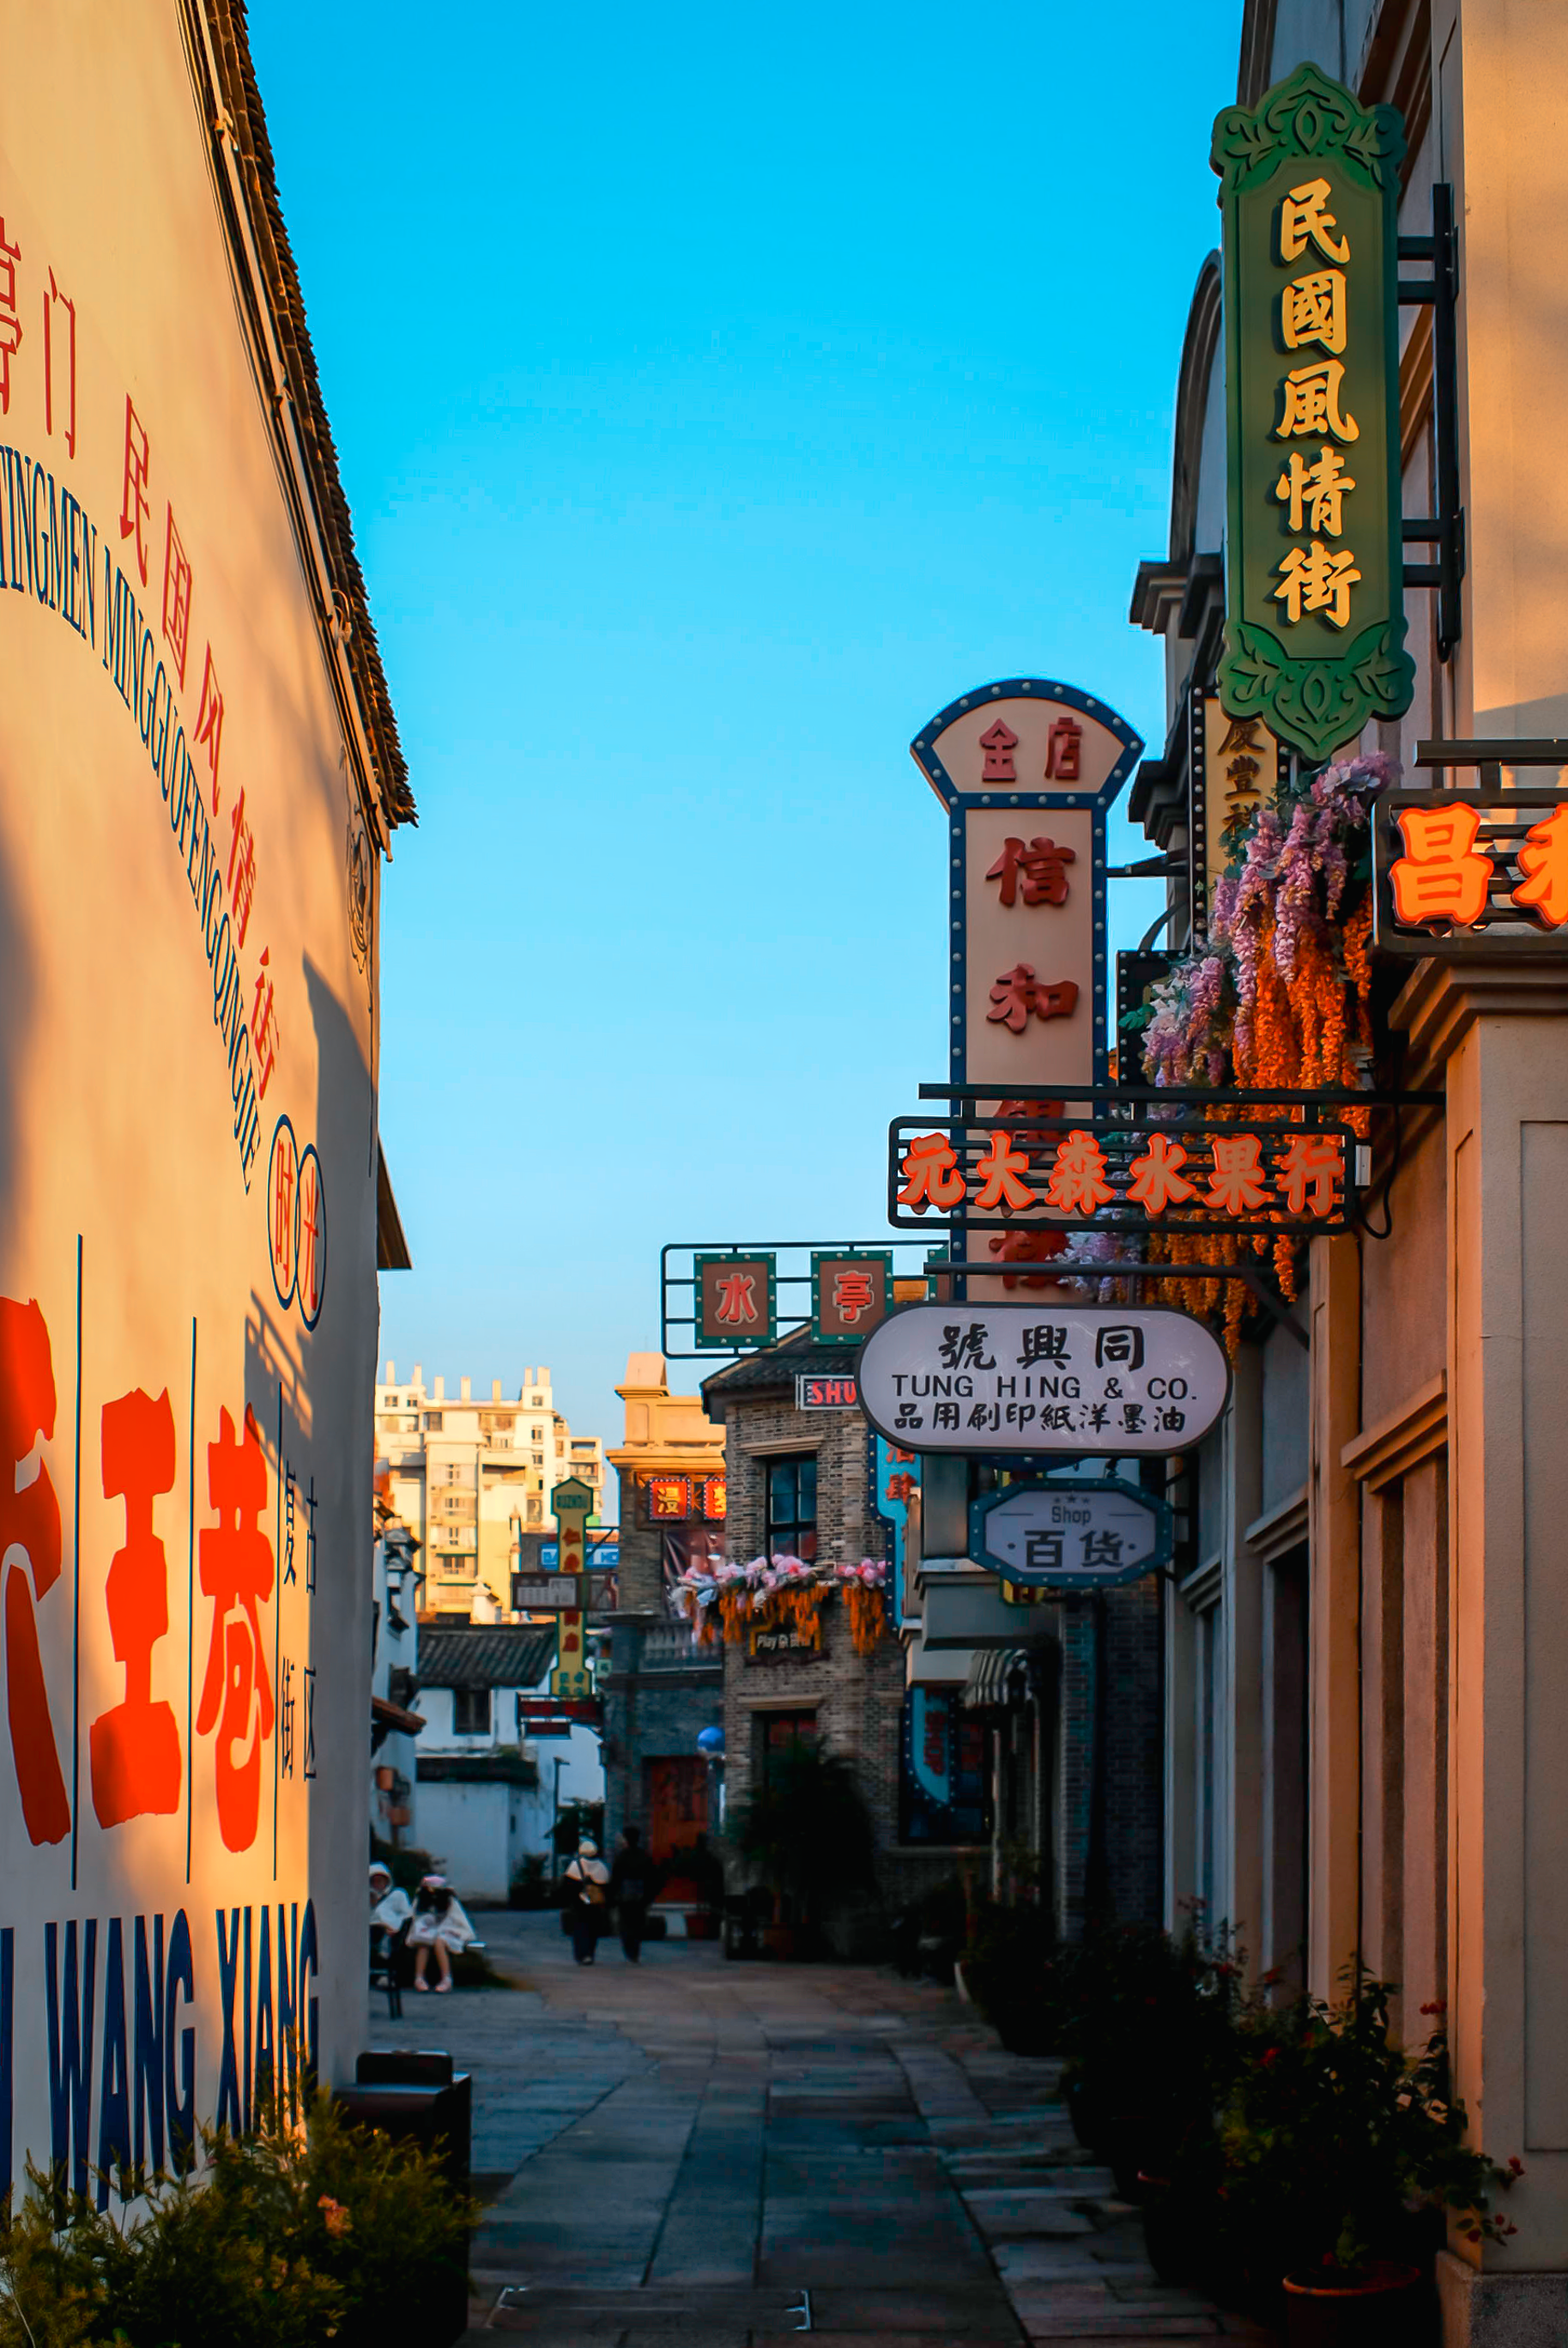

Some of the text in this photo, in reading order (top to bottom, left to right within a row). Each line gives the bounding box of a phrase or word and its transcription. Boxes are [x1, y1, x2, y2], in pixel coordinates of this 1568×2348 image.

[1275, 178, 1362, 631] 民國風情街
[978, 716, 1083, 782] 金店
[897, 1130, 1346, 1217] 元大森水果行
[716, 1271, 875, 1325] 水亭
[892, 1374, 1197, 1400] TUNG HING & CO.
[1051, 1505, 1092, 1526] Shop
[1024, 1529, 1124, 1568] 百货
[44, 1908, 197, 2233] WANG
